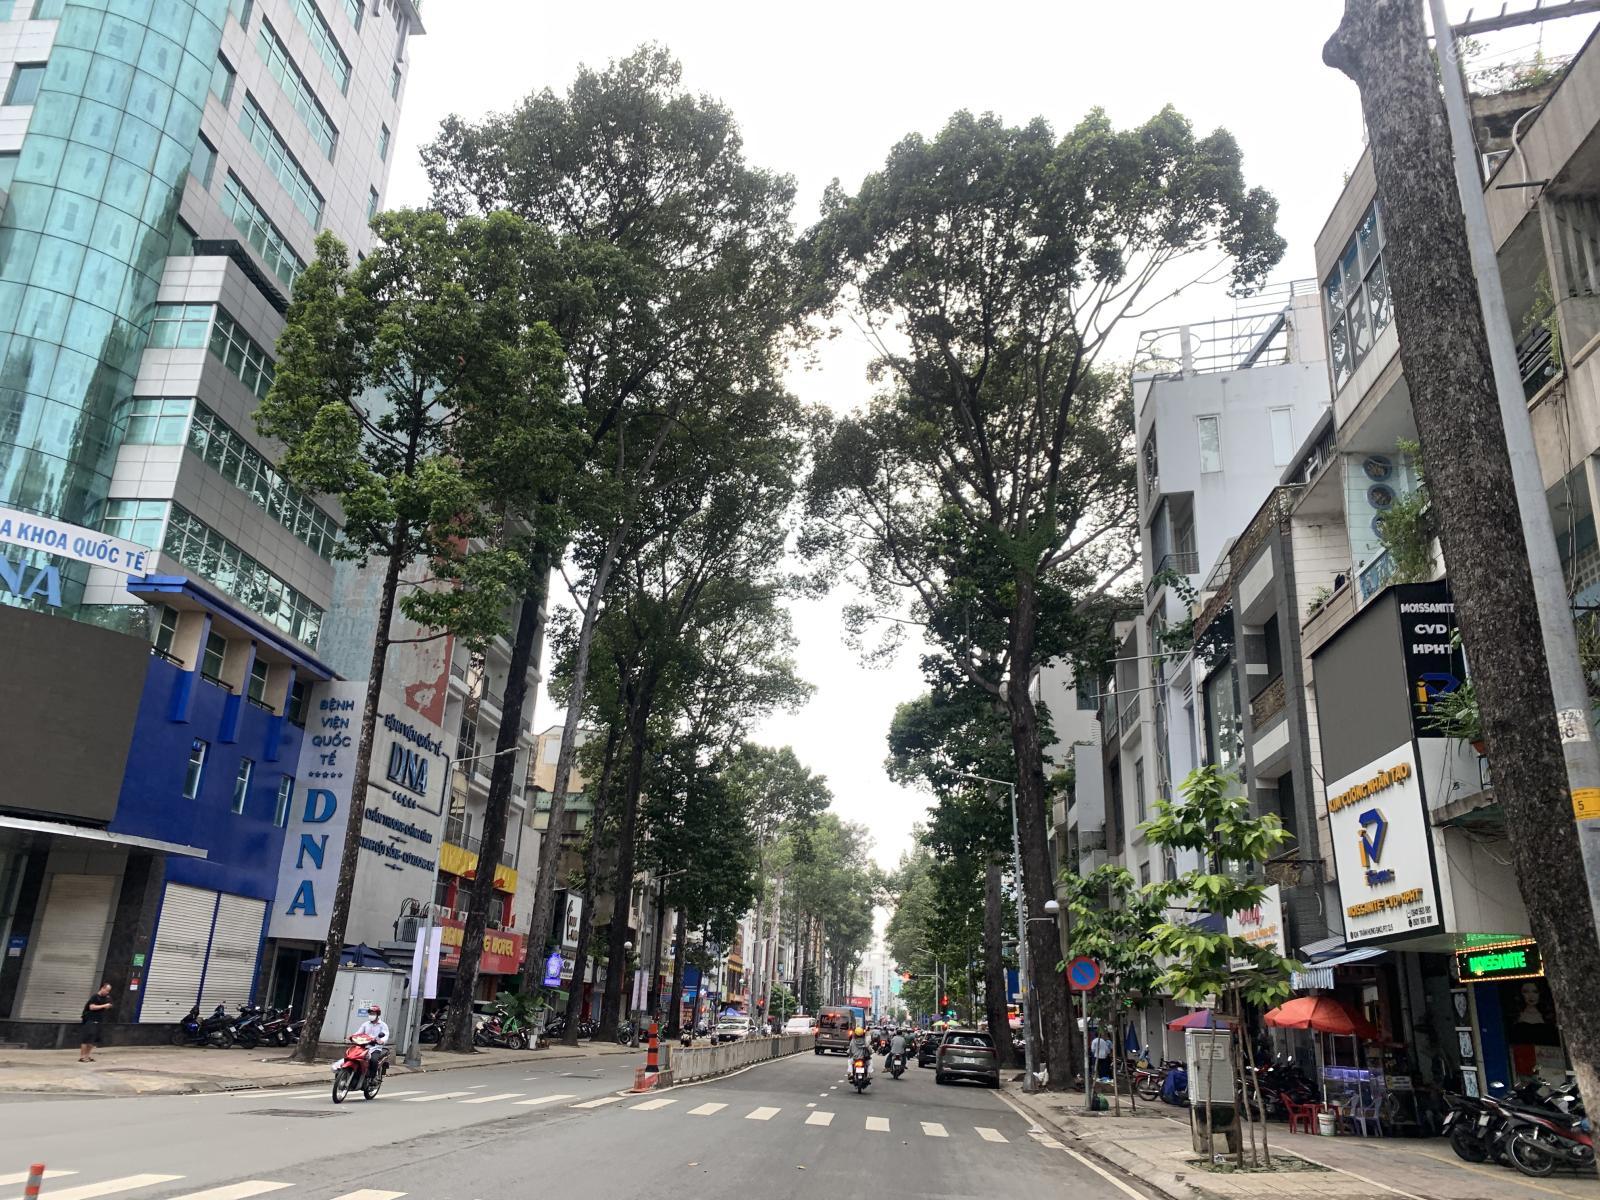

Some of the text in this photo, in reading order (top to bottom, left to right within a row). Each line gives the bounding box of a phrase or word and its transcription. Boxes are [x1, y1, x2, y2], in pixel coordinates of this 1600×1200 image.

[17, 522, 68, 551] KHOA
[72, 537, 119, 563] QUỐC
[125, 549, 149, 571] TẾ
[1414, 623, 1448, 635] CVD
[1412, 643, 1454, 655] HPHT
[319, 697, 355, 712] BỆNH
[321, 715, 350, 730] VIỆN
[311, 731, 351, 748] QUỐC
[320, 749, 337, 766] TẾ
[387, 741, 429, 796] DNA
[1328, 796, 1343, 814] KIM
[1576, 799, 1586, 812] 5
[285, 788, 338, 917] DNA
